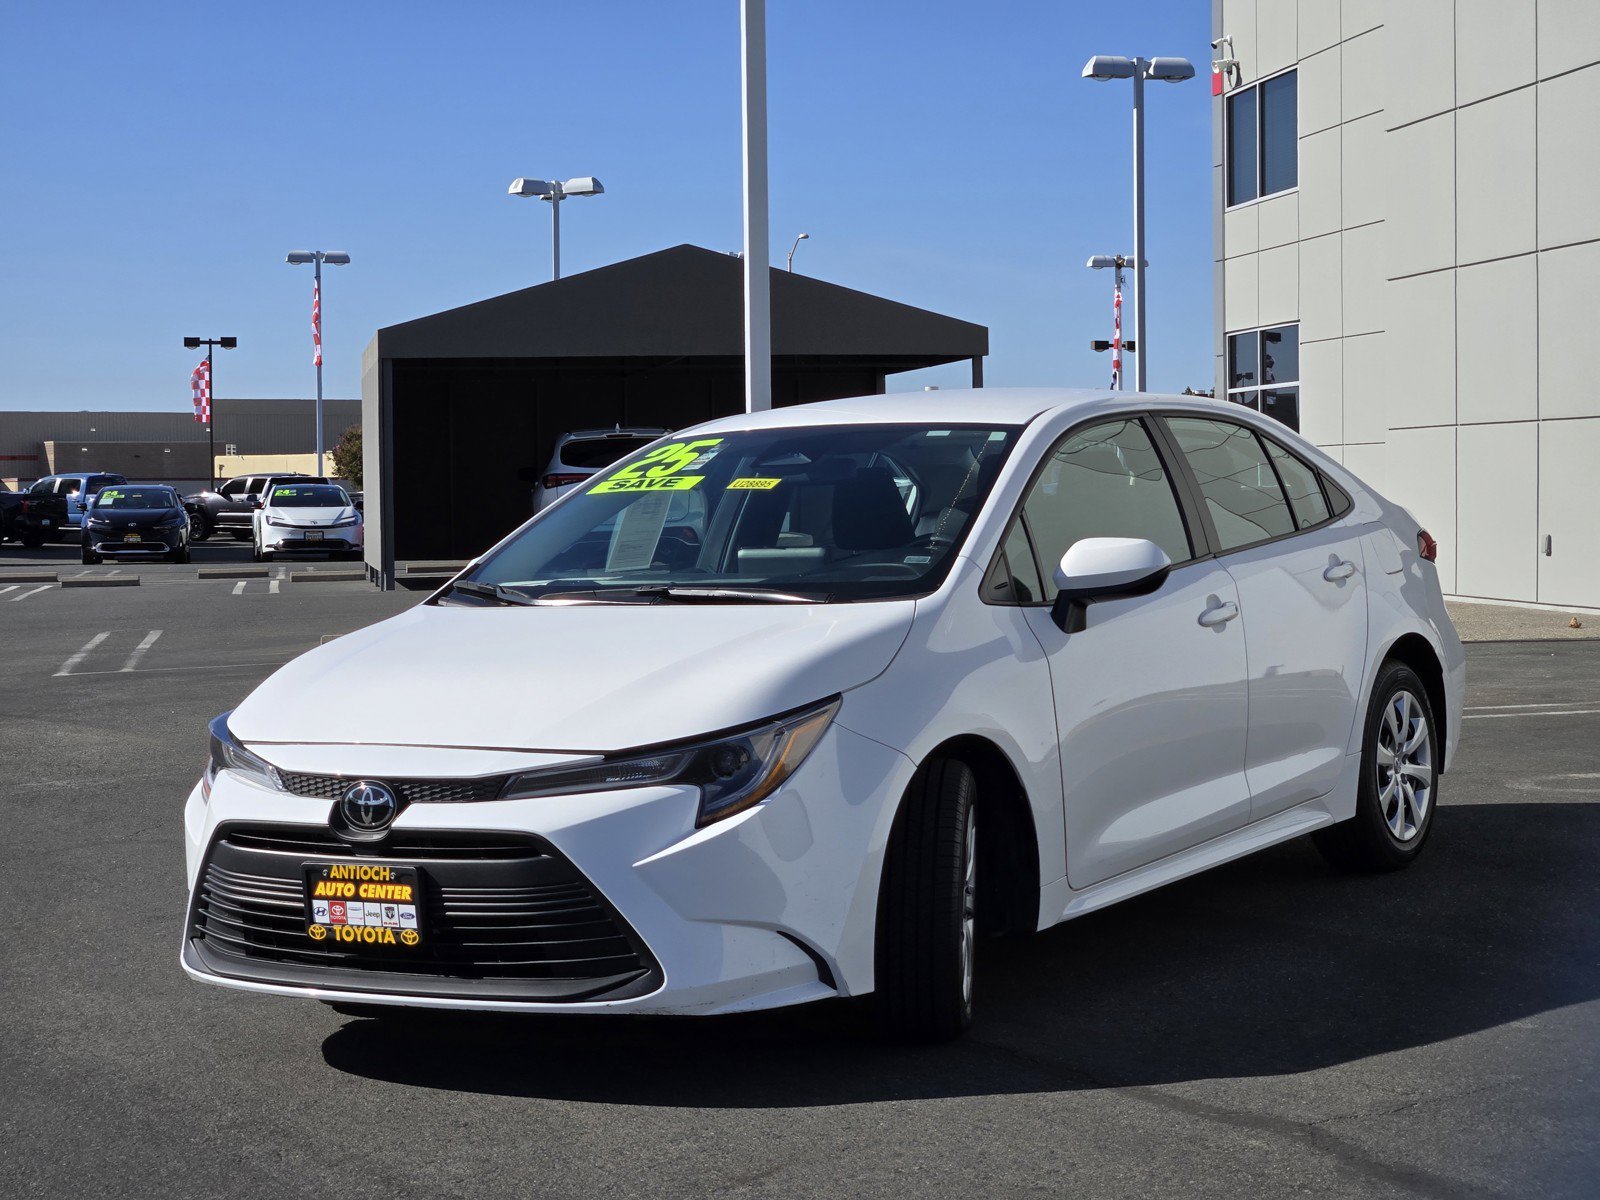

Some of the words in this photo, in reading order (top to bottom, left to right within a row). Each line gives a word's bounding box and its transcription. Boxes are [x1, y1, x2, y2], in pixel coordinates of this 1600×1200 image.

[608, 438, 724, 481] 25
[611, 477, 679, 490] SAVE
[330, 865, 390, 881] ANTIOCH
[315, 882, 355, 897] AUTO
[359, 884, 412, 900] CENTER
[365, 910, 381, 918] Jeep
[333, 925, 396, 944] TOYOTA
